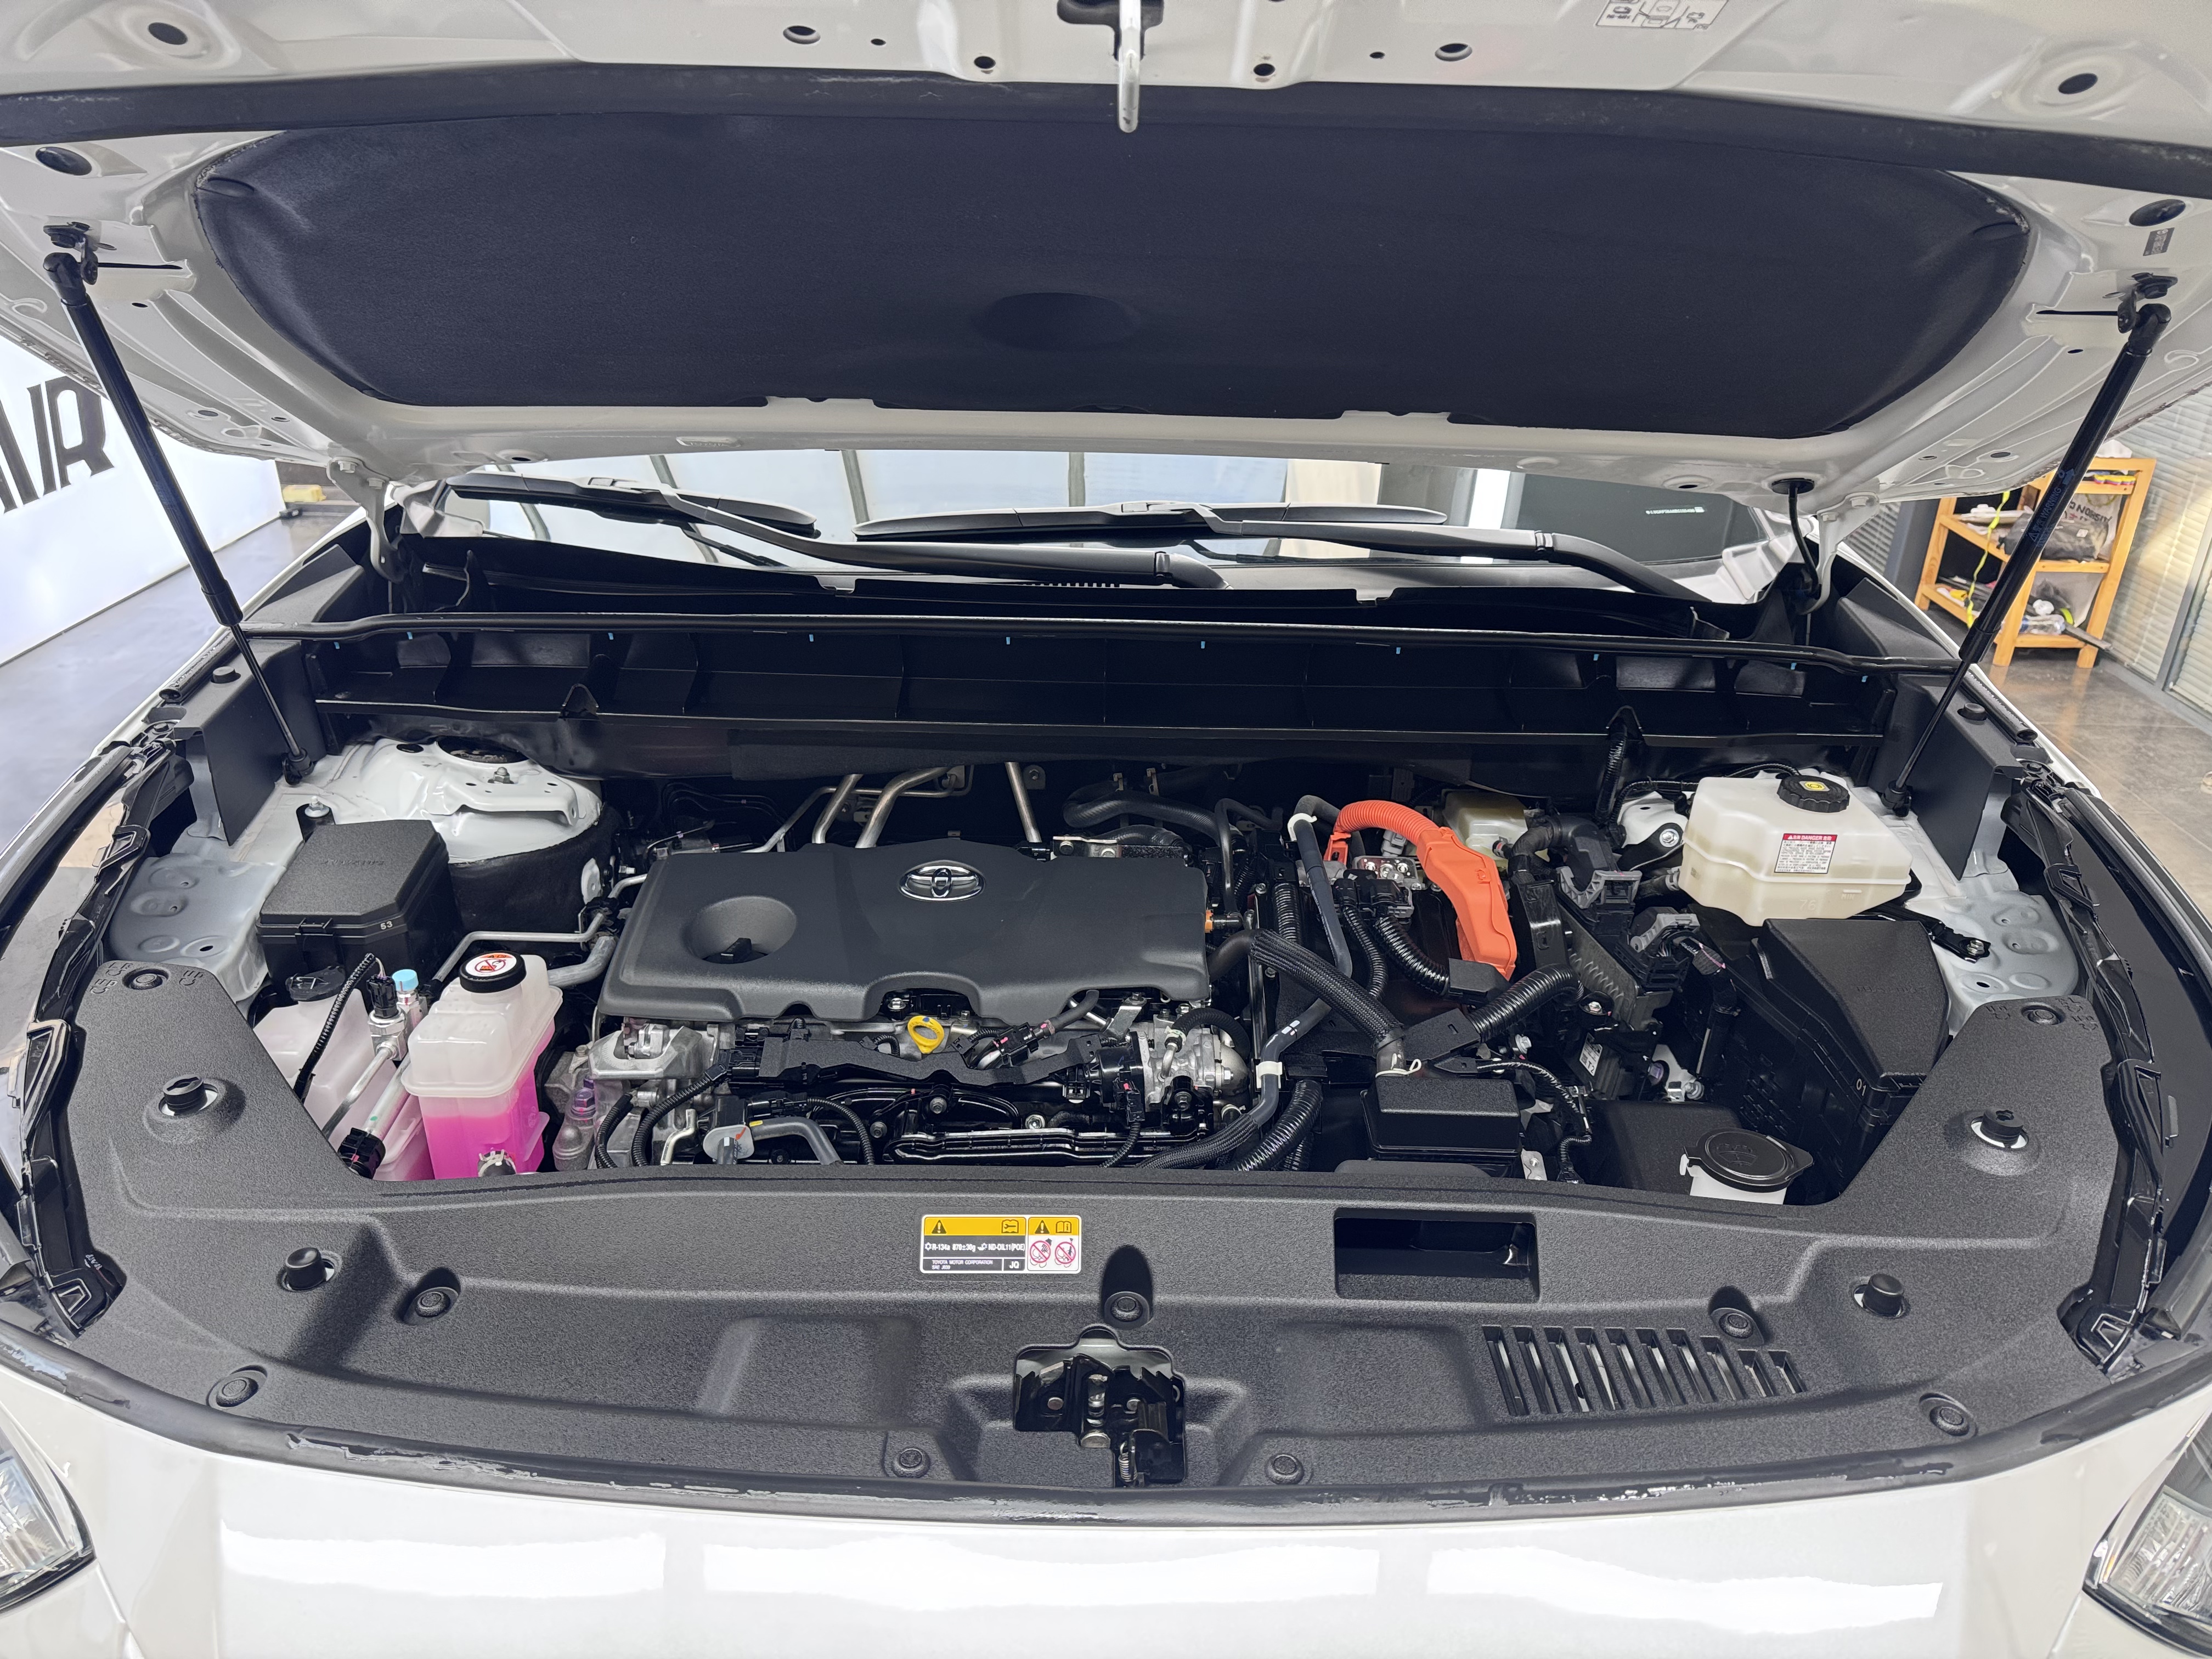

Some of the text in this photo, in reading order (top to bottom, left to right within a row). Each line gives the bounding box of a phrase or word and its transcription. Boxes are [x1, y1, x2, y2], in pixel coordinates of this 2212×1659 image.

[2040, 487, 2062, 519] WARNING
[1799, 899, 1817, 911] 76
[380, 920, 393, 930] 53
[1856, 1078, 1867, 1097] 01
[952, 1243, 976, 1252] 870±30g
[988, 1243, 1025, 1251] ND-OIL11(POE)
[1009, 1261, 1020, 1269] JQ
